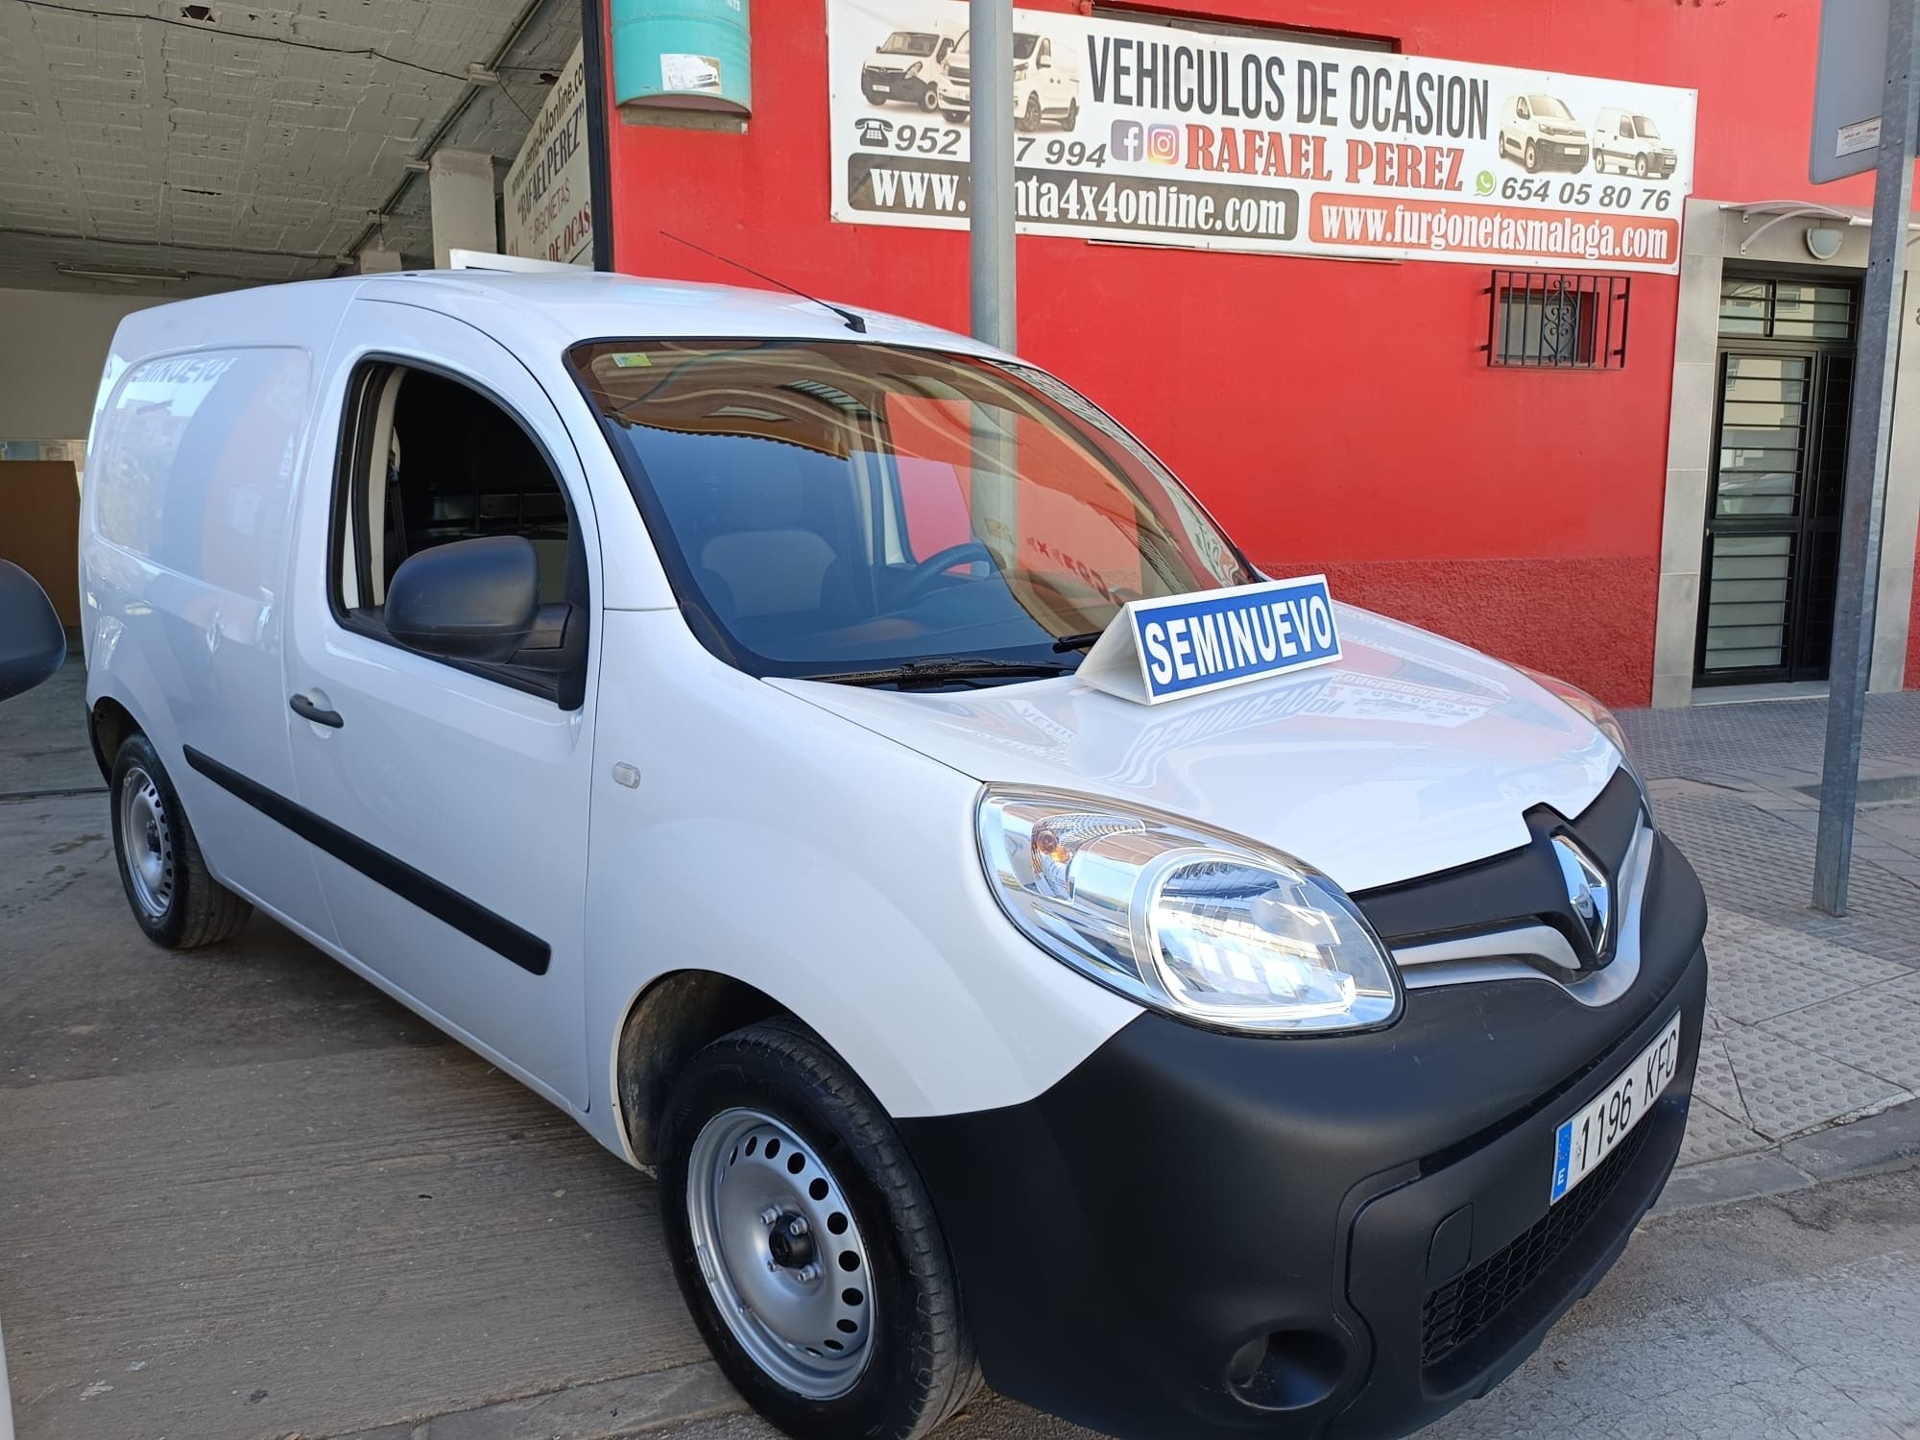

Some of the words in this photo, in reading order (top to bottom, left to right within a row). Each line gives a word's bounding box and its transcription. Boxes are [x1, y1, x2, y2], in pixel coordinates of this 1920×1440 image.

[1087, 34, 1286, 122] VEHICULOS
[1297, 59, 1339, 126] DE
[1349, 65, 1489, 140] OCASION
[894, 123, 962, 156] 952
[1045, 137, 1108, 169] 994
[1185, 123, 1333, 182] RAFAEL
[1345, 138, 1465, 192] PEREZ
[869, 167, 1286, 236] www.nta4x4online.com
[1500, 176, 1550, 204] 654
[1559, 181, 1591, 206] 05
[1598, 184, 1632, 209] 80
[1640, 187, 1671, 213] 76
[1320, 203, 1668, 261] www.furgonetasmalaga.com
[1144, 595, 1333, 686] SEMINUEVO
[1581, 1077, 1633, 1172] 1196
[1643, 1028, 1677, 1107] KFC
[1557, 1168, 1566, 1186] E
